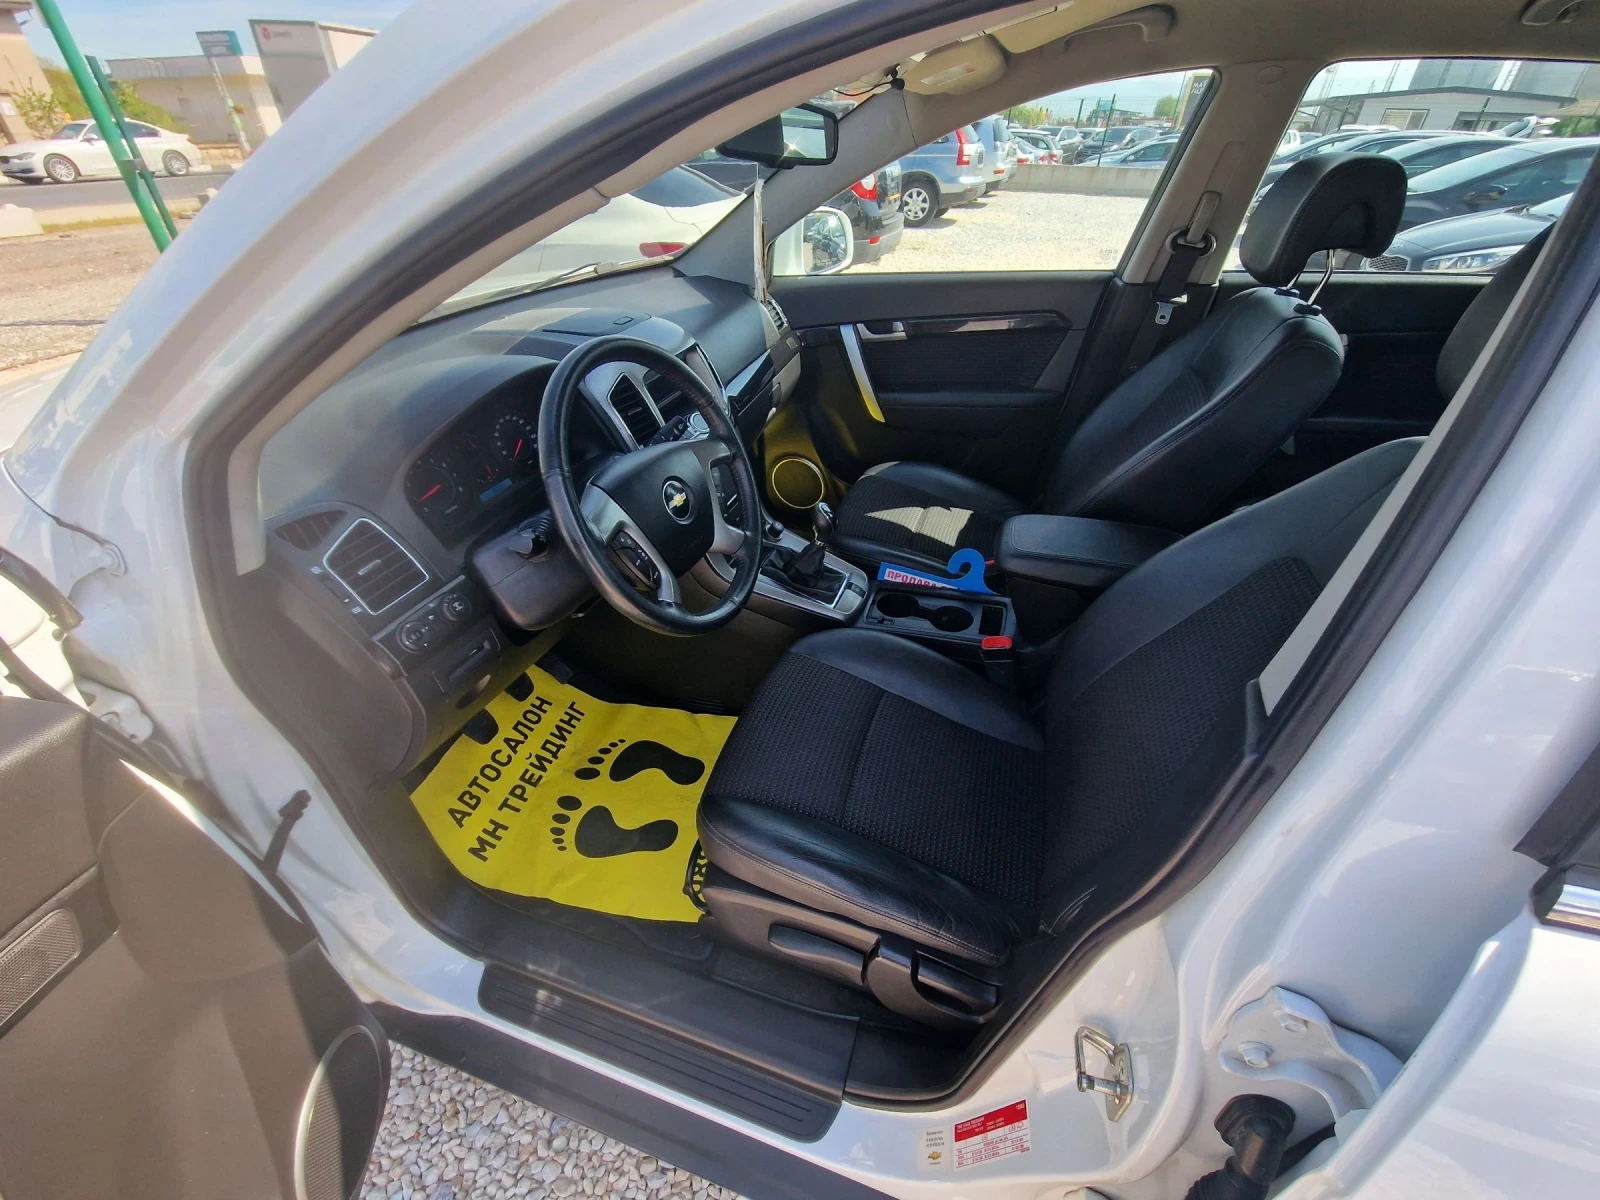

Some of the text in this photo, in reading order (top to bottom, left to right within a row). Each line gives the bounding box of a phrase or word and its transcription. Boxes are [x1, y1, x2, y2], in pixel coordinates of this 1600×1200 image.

[447, 696, 553, 828] АВТОСАЛОН
[468, 701, 586, 862] МН ТРЕЙДИНГ
